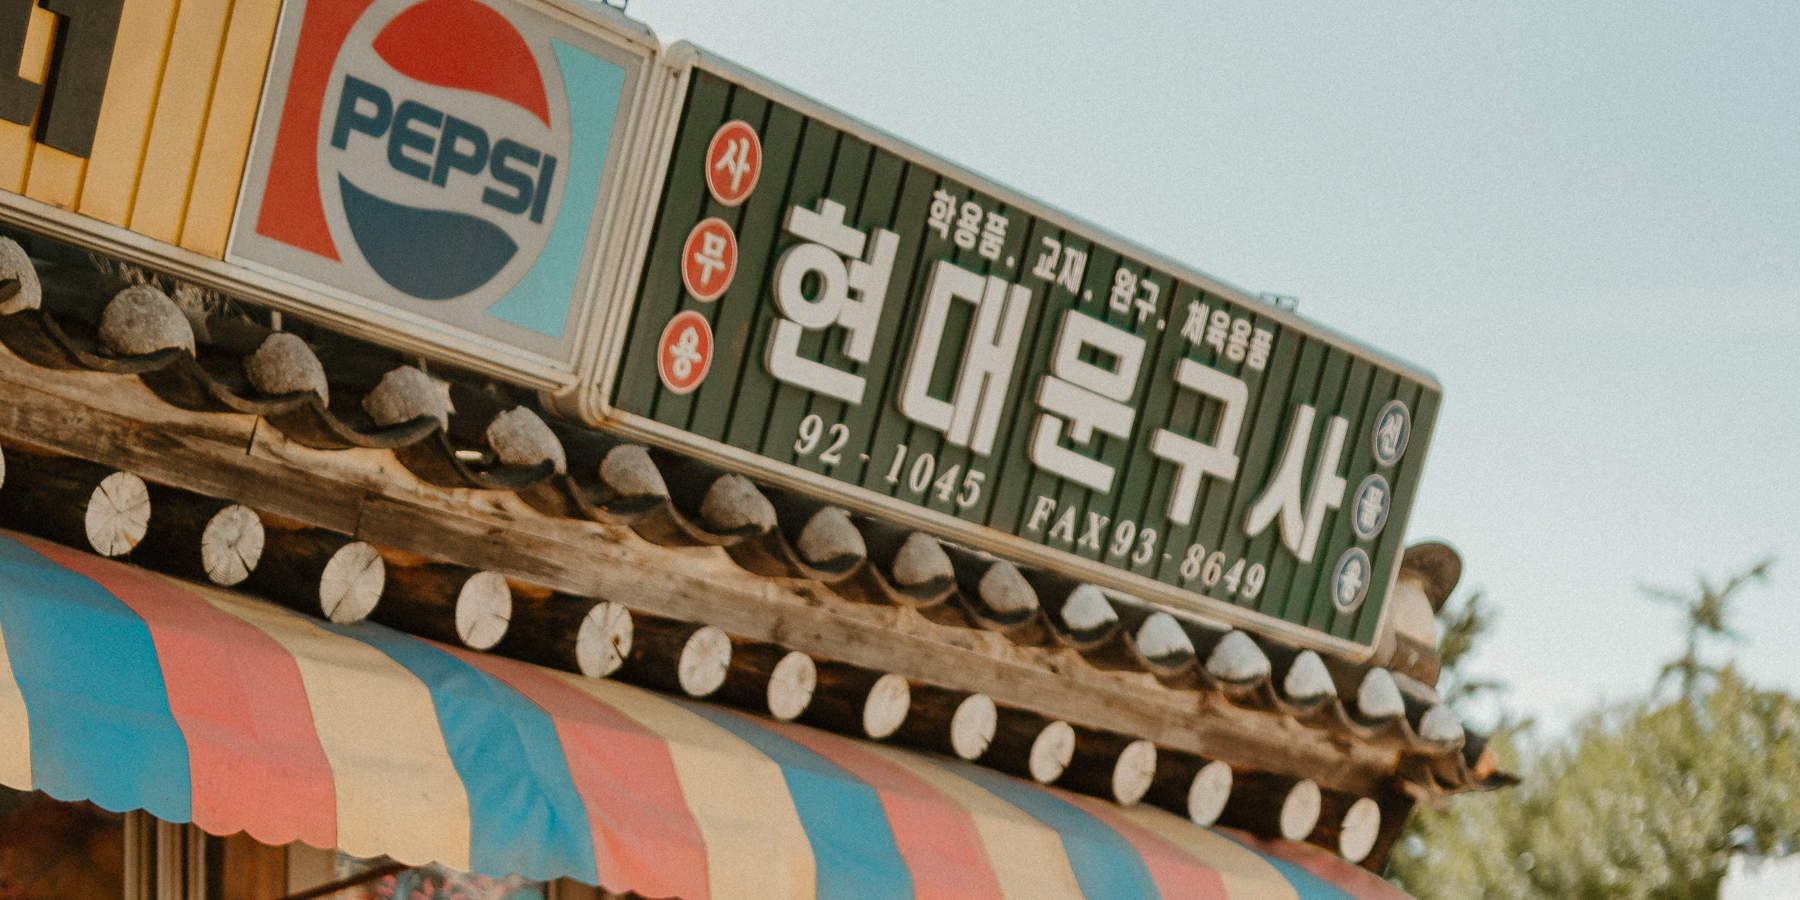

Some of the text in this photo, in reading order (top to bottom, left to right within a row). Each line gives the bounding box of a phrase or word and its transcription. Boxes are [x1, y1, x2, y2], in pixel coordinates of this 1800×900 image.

[331, 74, 558, 224] PEPSI
[670, 136, 750, 377] 사무용
[764, 198, 1349, 563] 현대문구사
[1027, 496, 1110, 551] FAX
